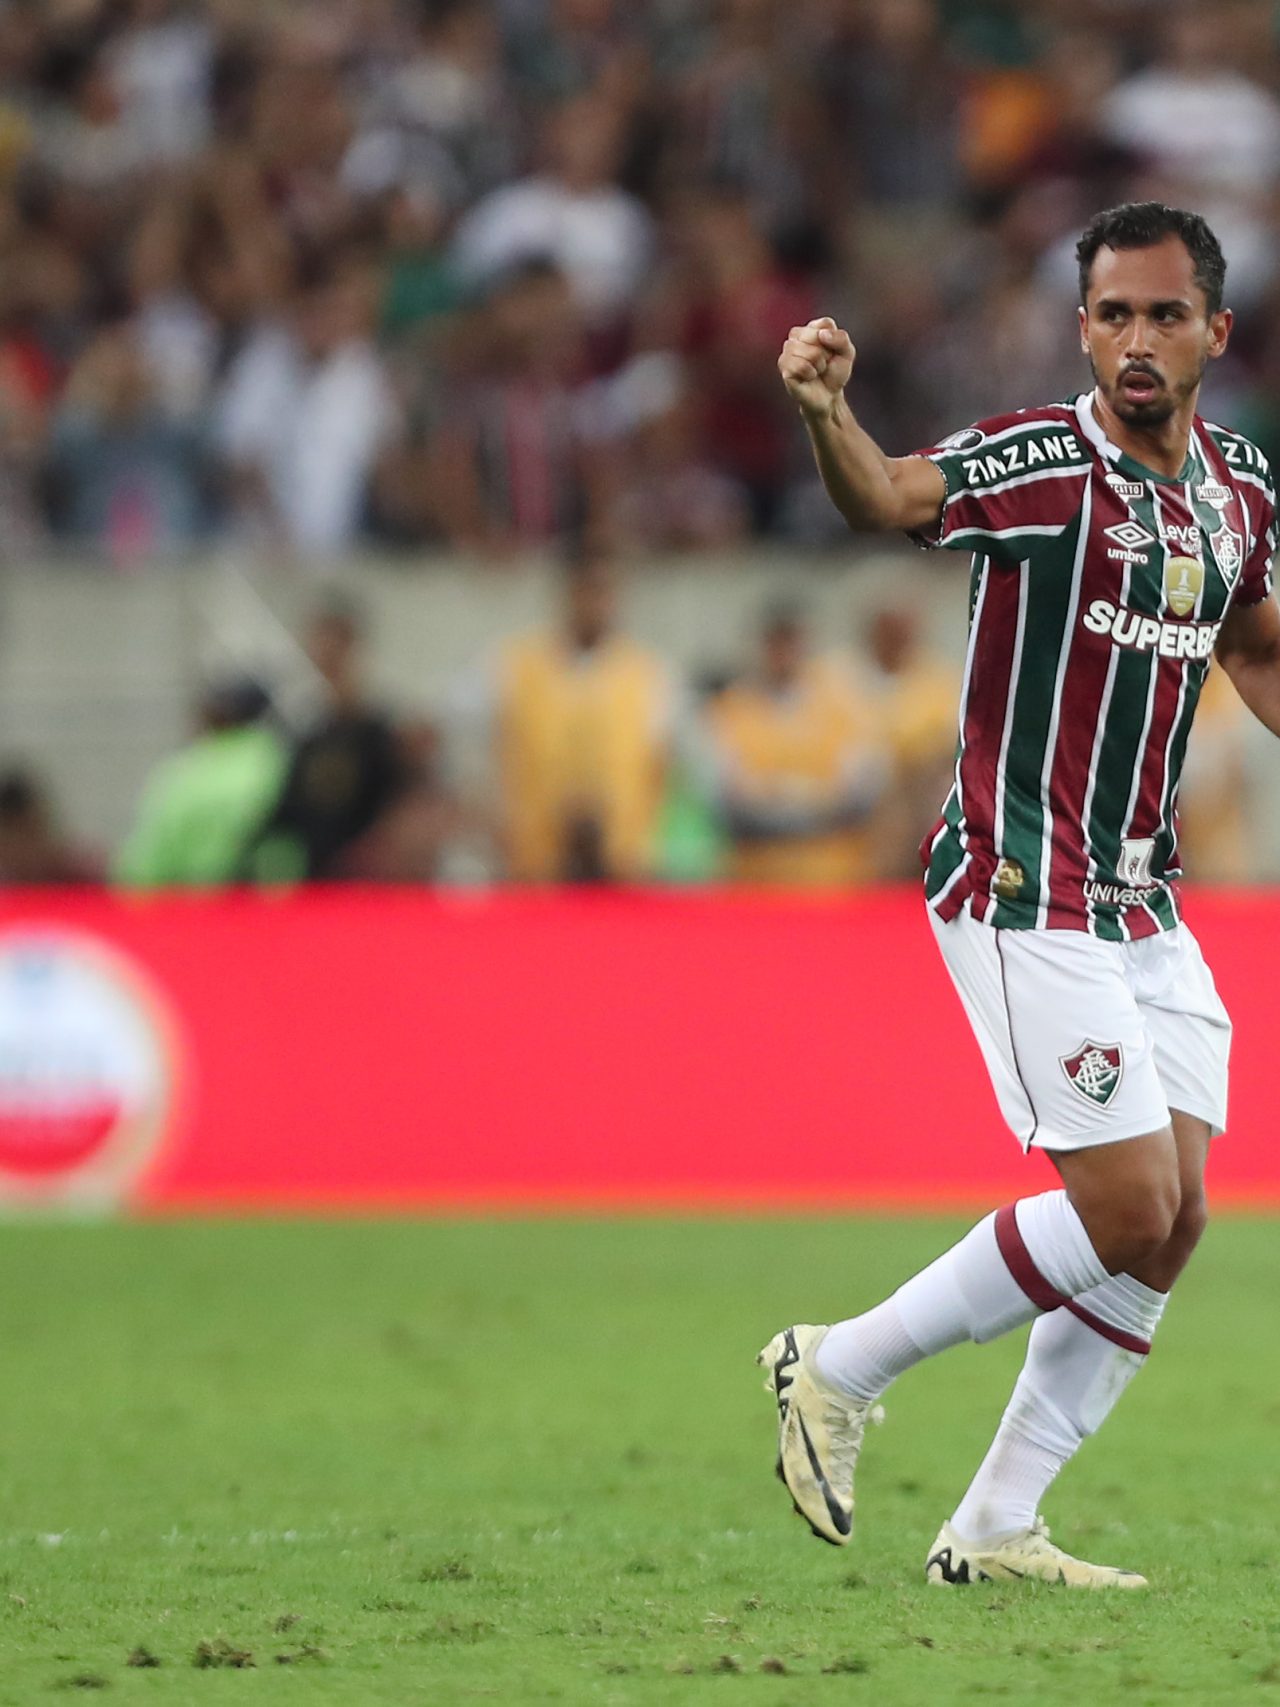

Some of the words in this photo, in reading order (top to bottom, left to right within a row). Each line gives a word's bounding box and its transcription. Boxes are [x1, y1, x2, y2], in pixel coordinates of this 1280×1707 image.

[962, 434, 1082, 485] ZINZANE
[1157, 519, 1200, 541] Leve
[1107, 547, 1149, 565] umbro
